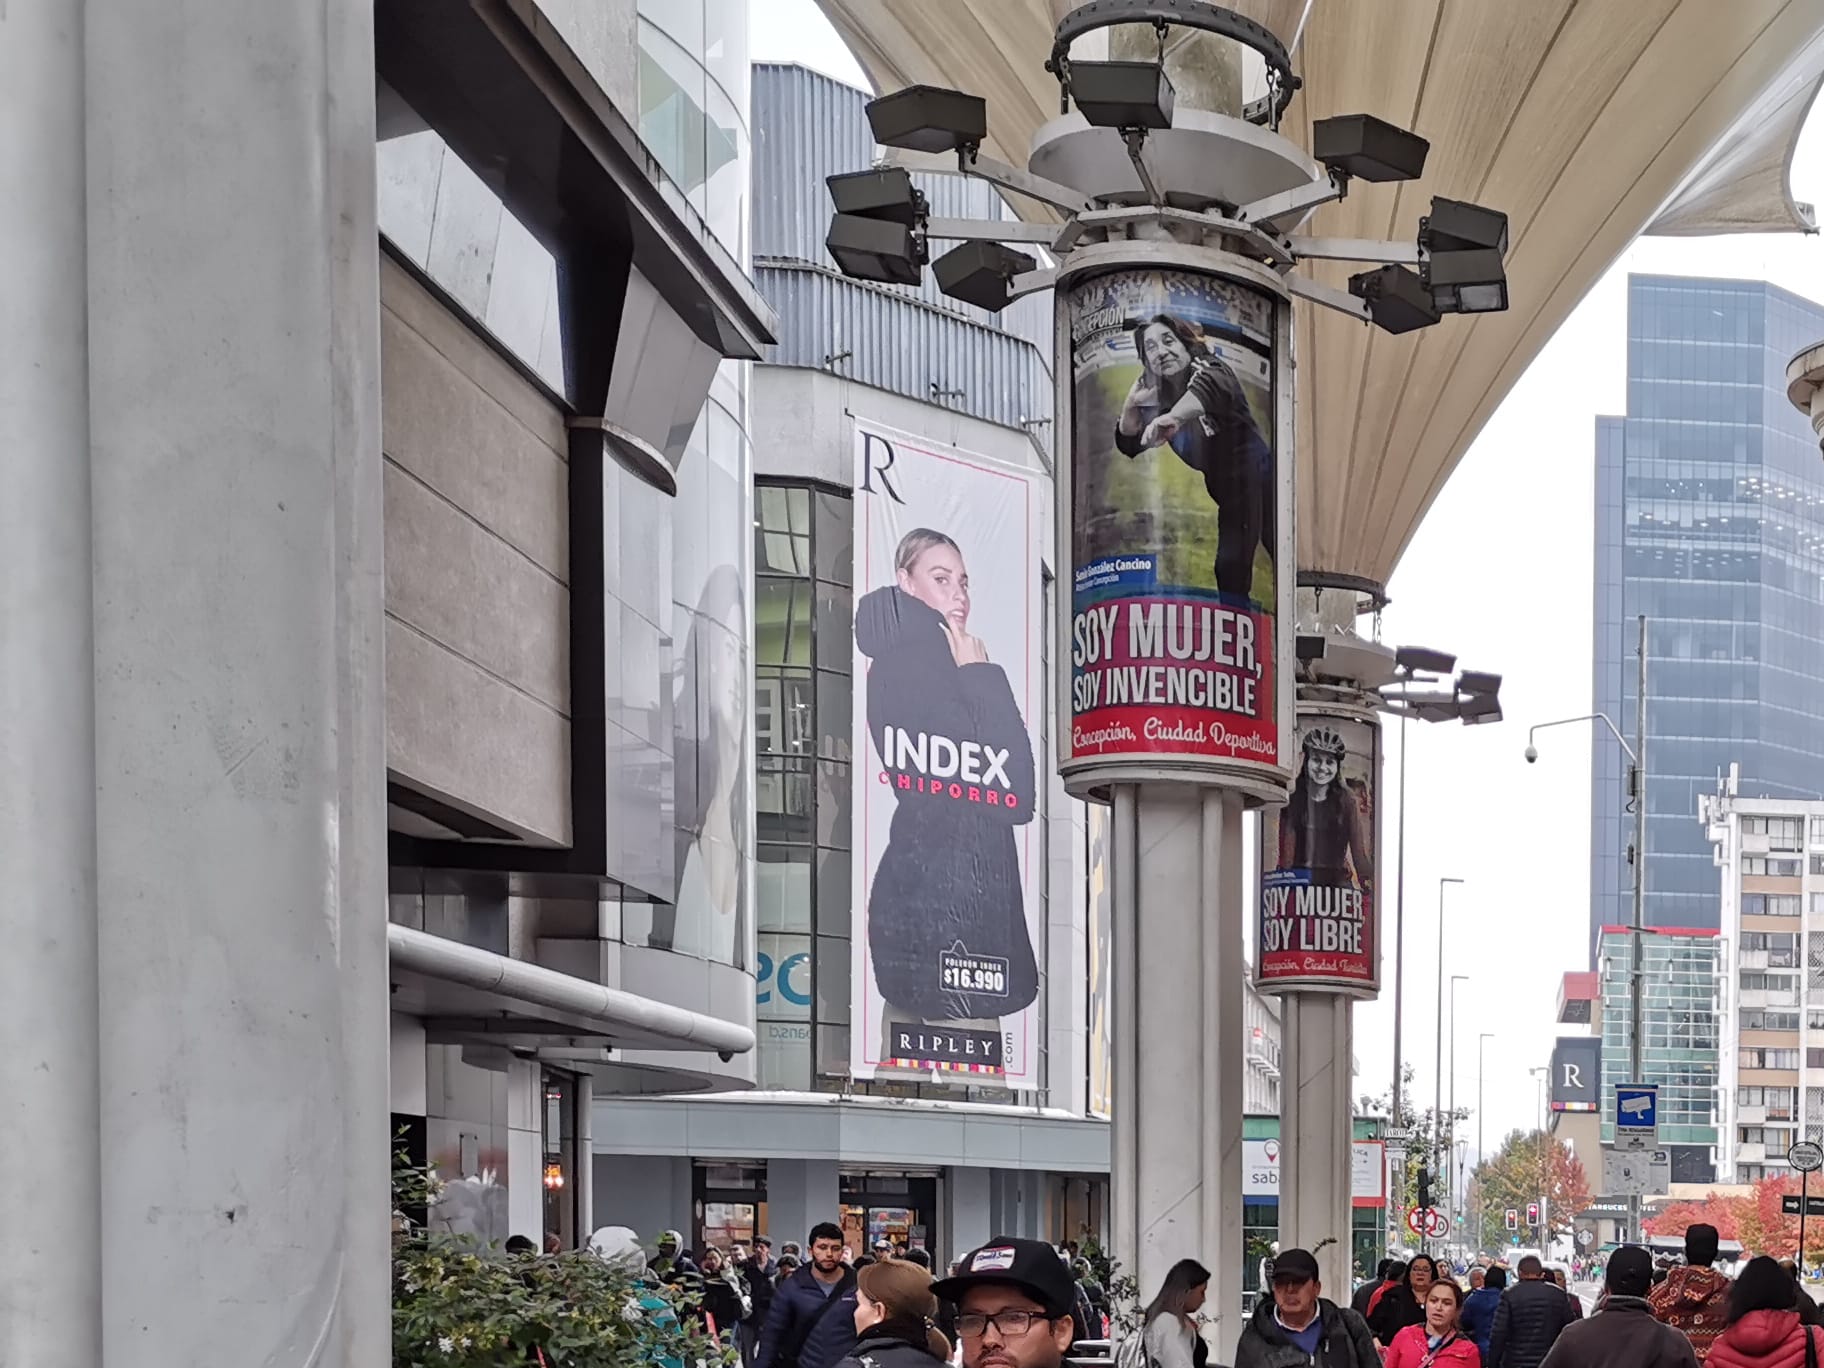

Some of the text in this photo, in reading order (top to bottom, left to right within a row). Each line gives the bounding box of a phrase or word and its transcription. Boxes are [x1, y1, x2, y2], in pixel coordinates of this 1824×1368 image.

[858, 429, 906, 505] R
[1115, 558, 1152, 571] Cancino
[1073, 602, 1262, 679] SOY MUJER,
[1073, 666, 1256, 715] SOY INVENCIBLE
[1073, 716, 1276, 756] Concepción, Ciudad Deportiva
[883, 725, 1011, 789] INDEX
[878, 771, 1018, 808] CHIPORRO
[1263, 885, 1366, 924] SOY MUJER,
[1263, 918, 1363, 954] SOY LIBRE
[944, 967, 1004, 991] $16.990
[900, 1034, 993, 1056] RIPLEY
[1562, 1063, 1584, 1088] R
